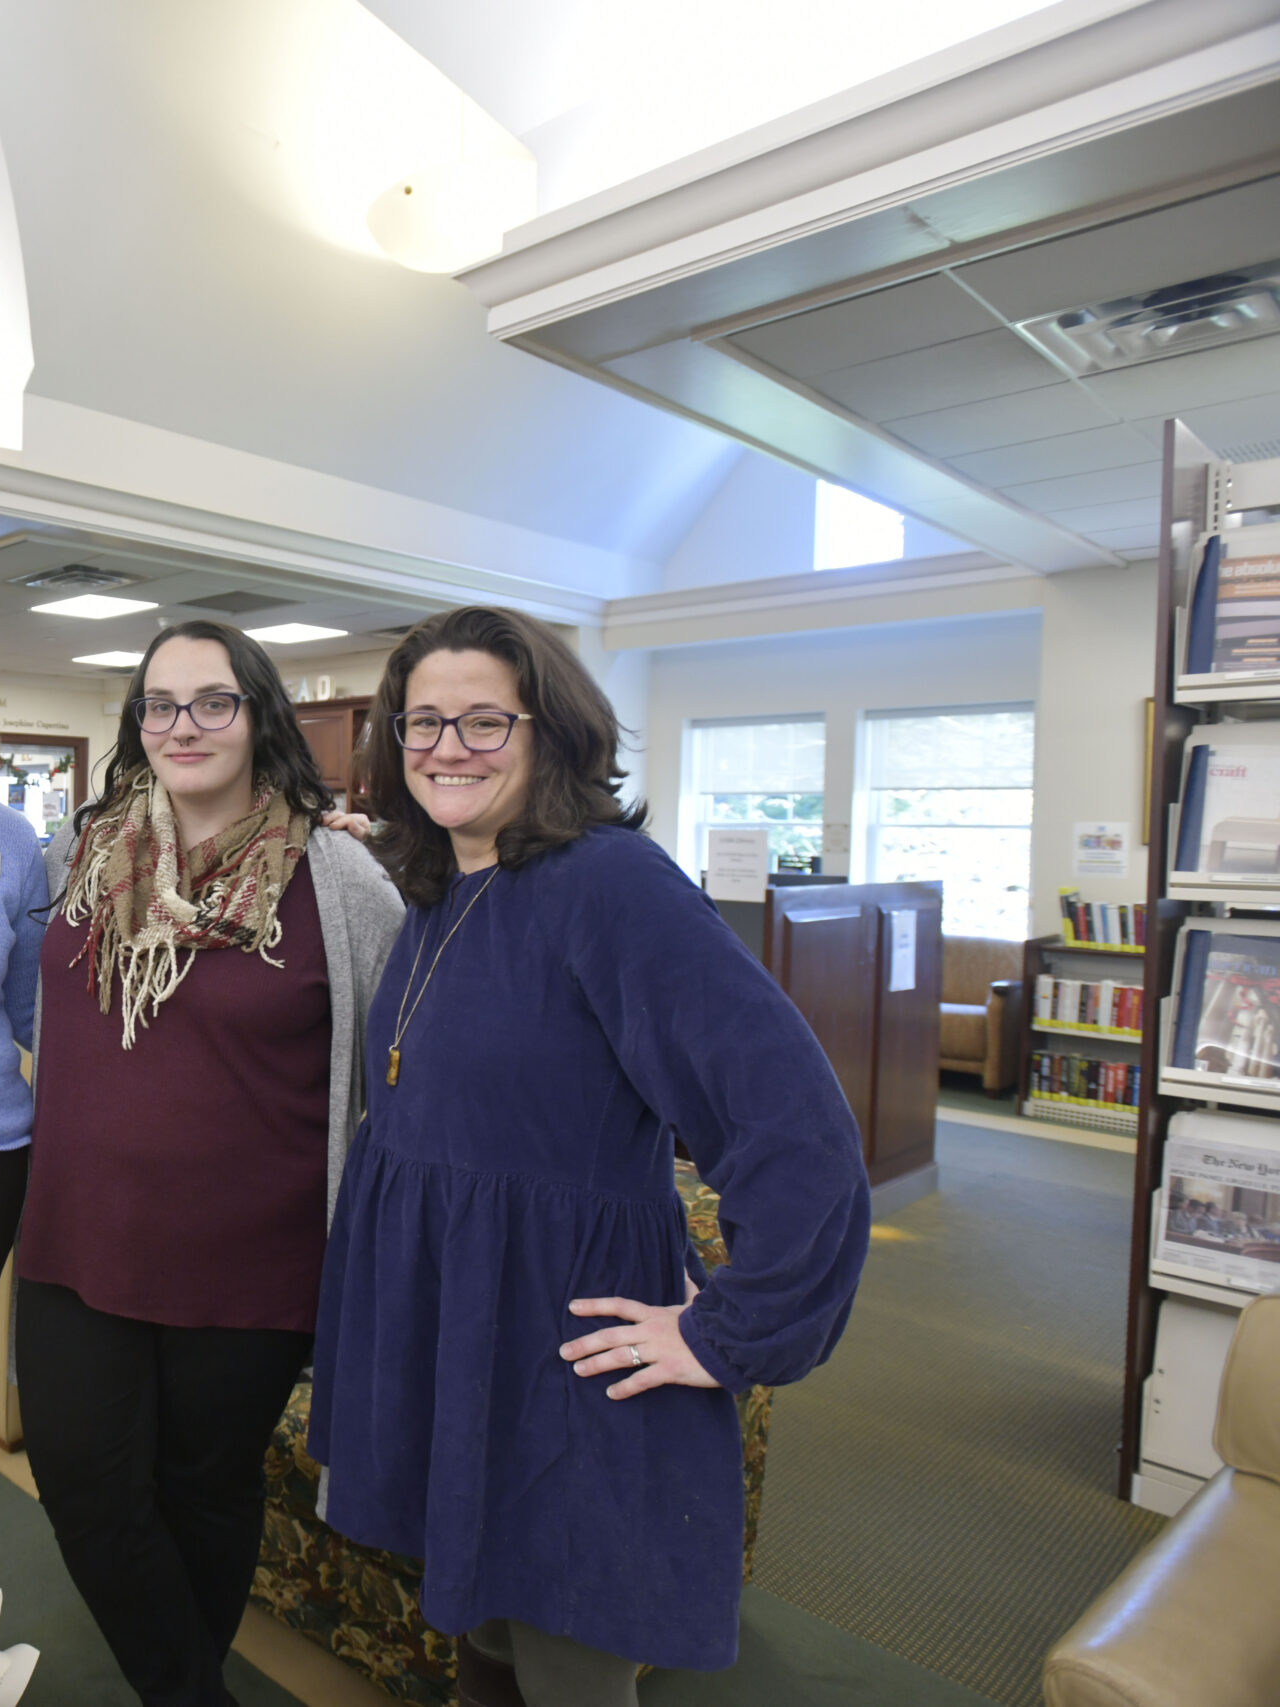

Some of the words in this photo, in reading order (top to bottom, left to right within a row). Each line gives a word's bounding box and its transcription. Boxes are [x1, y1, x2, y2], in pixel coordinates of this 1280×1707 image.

[1209, 764, 1247, 778] craft
[1201, 1154, 1225, 1168] The
[1227, 1158, 1255, 1172] New
